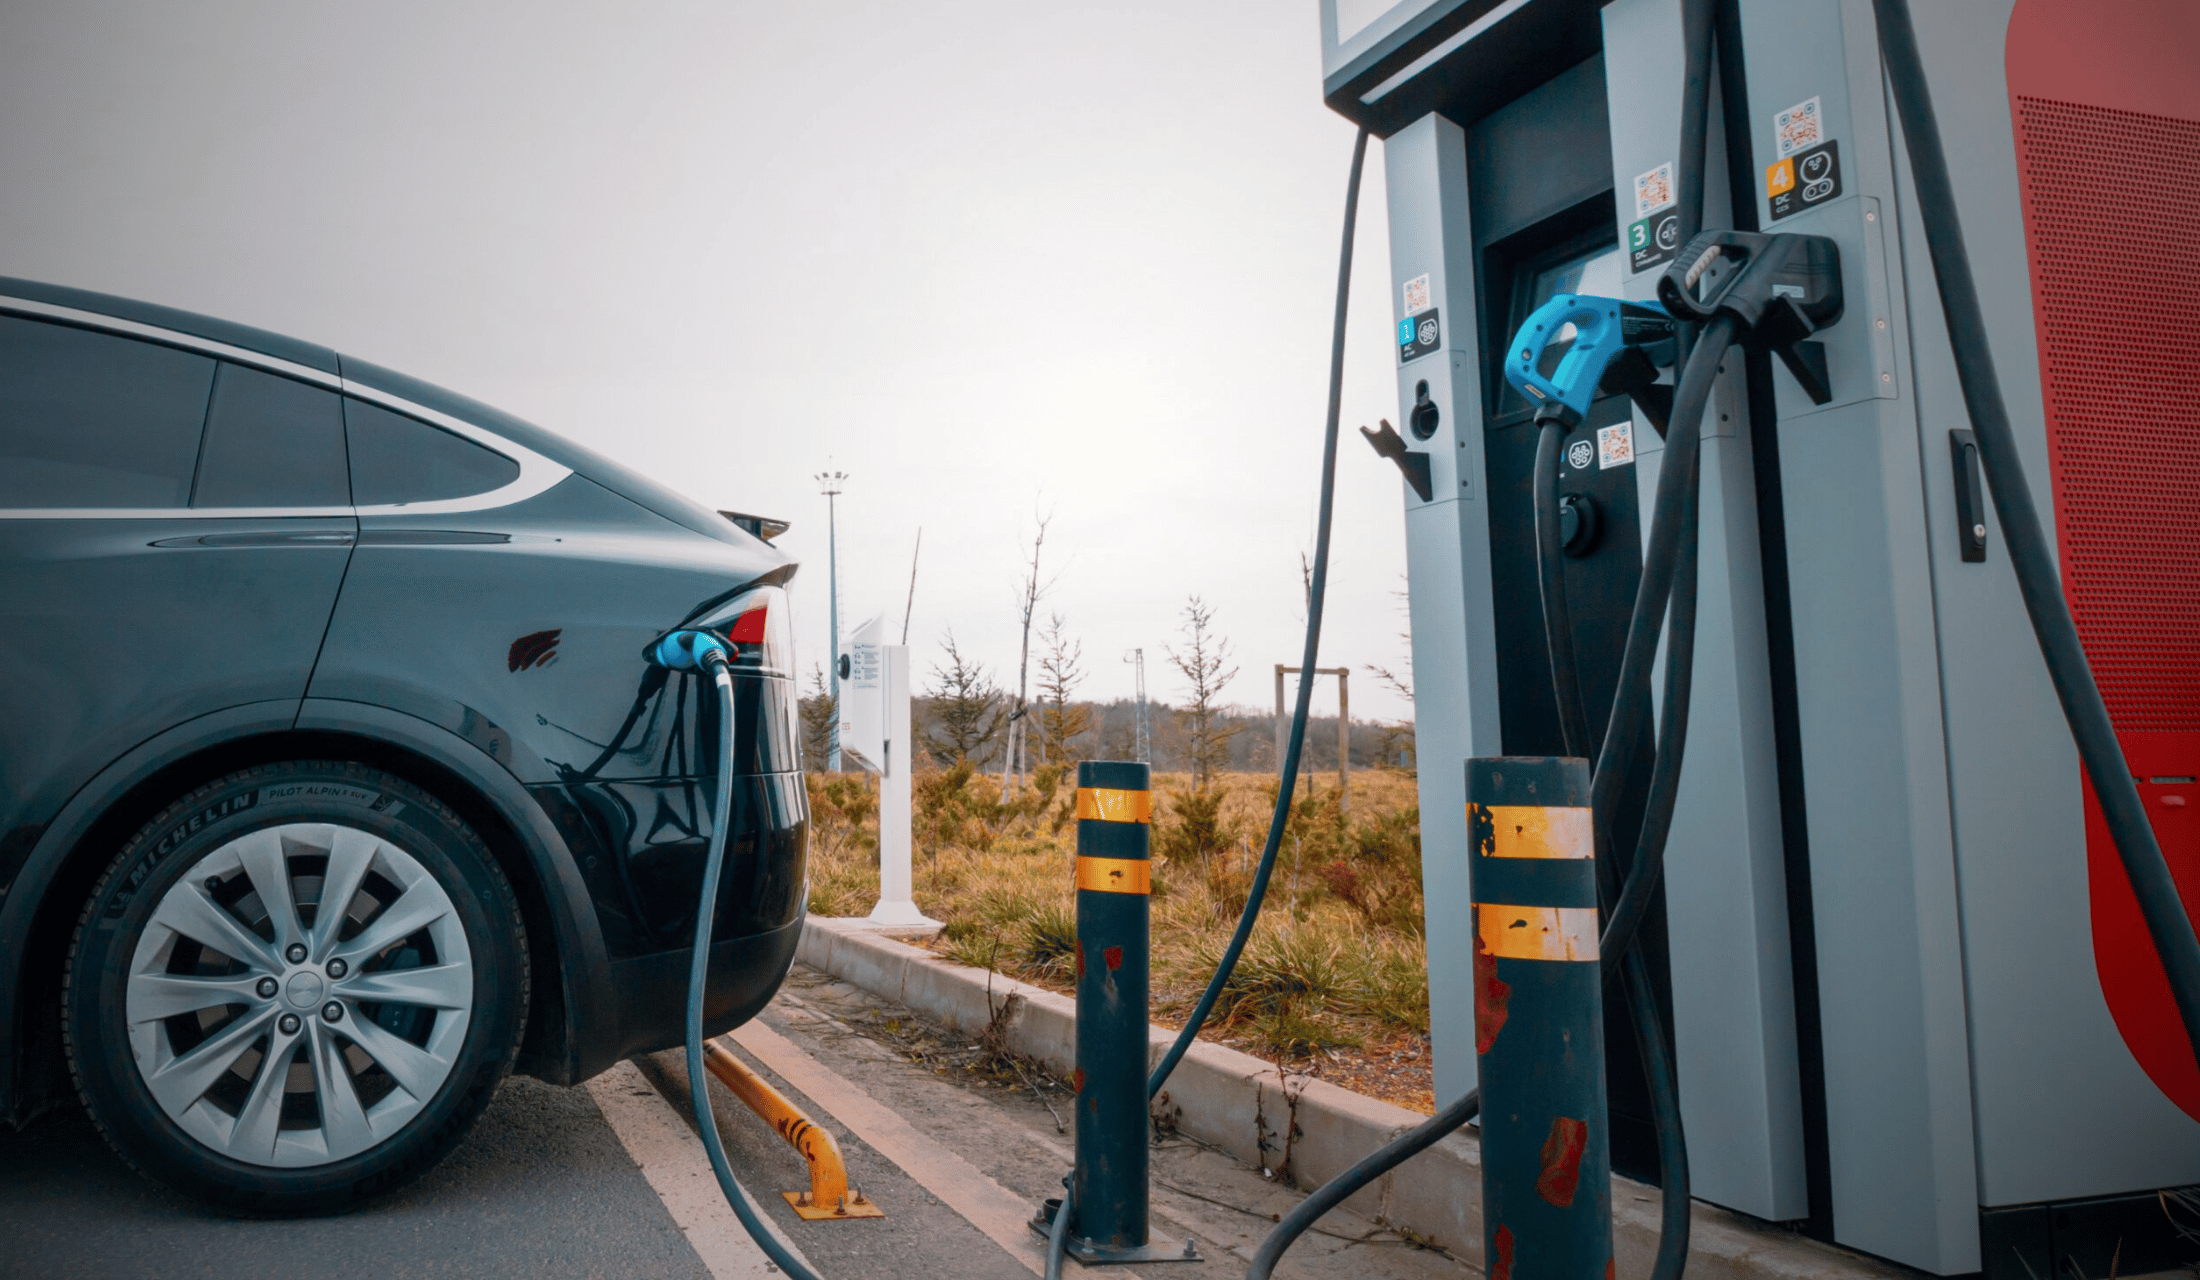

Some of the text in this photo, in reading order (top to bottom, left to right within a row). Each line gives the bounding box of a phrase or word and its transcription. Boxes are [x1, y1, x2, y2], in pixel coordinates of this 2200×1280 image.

[1773, 166, 1788, 188] 4
[1775, 193, 1790, 206] DC
[1632, 224, 1646, 246] 3
[1635, 249, 1648, 260] DC
[130, 793, 250, 887] MICHELIN
[269, 786, 302, 799] PILOT
[305, 786, 341, 797] ALPIN
